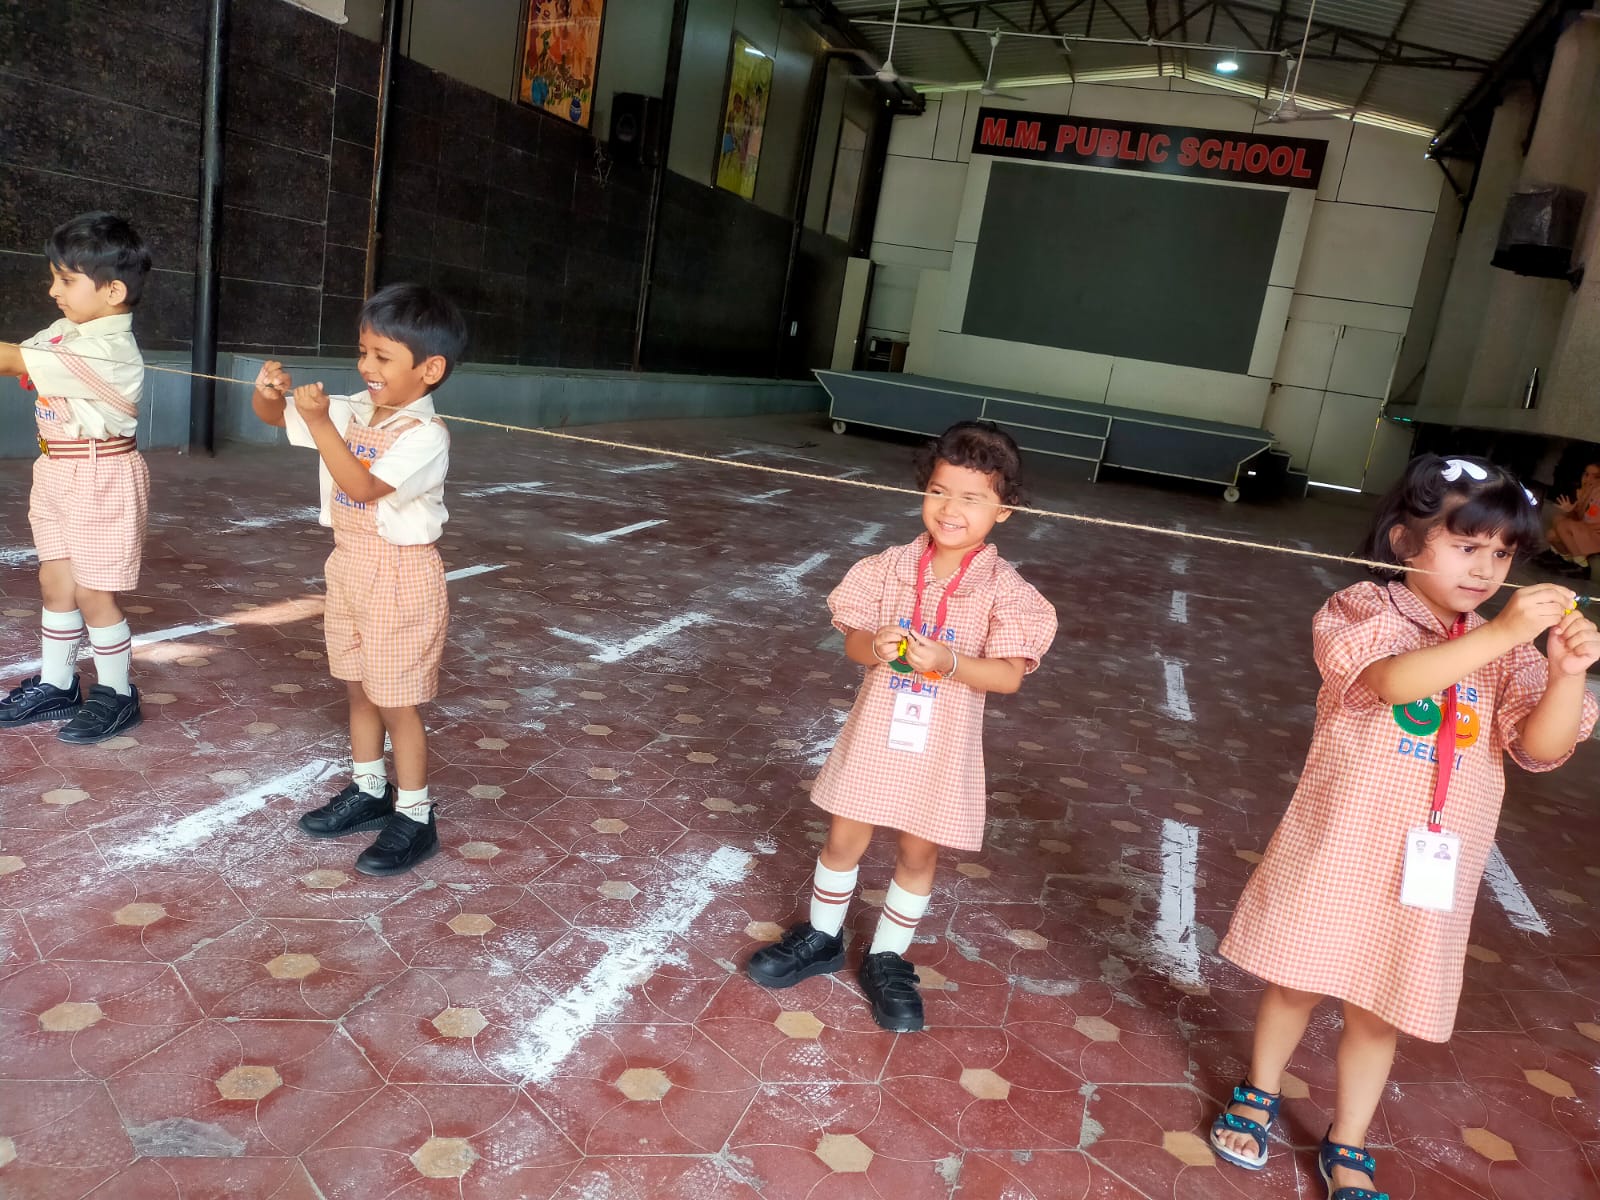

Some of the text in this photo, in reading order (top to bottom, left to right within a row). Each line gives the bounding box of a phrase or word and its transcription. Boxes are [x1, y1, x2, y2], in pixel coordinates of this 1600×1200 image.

[980, 117, 1312, 179] M.M. PUBLIC SCHOOL
[889, 675, 938, 698] DEHI
[1398, 737, 1463, 770] DELI
